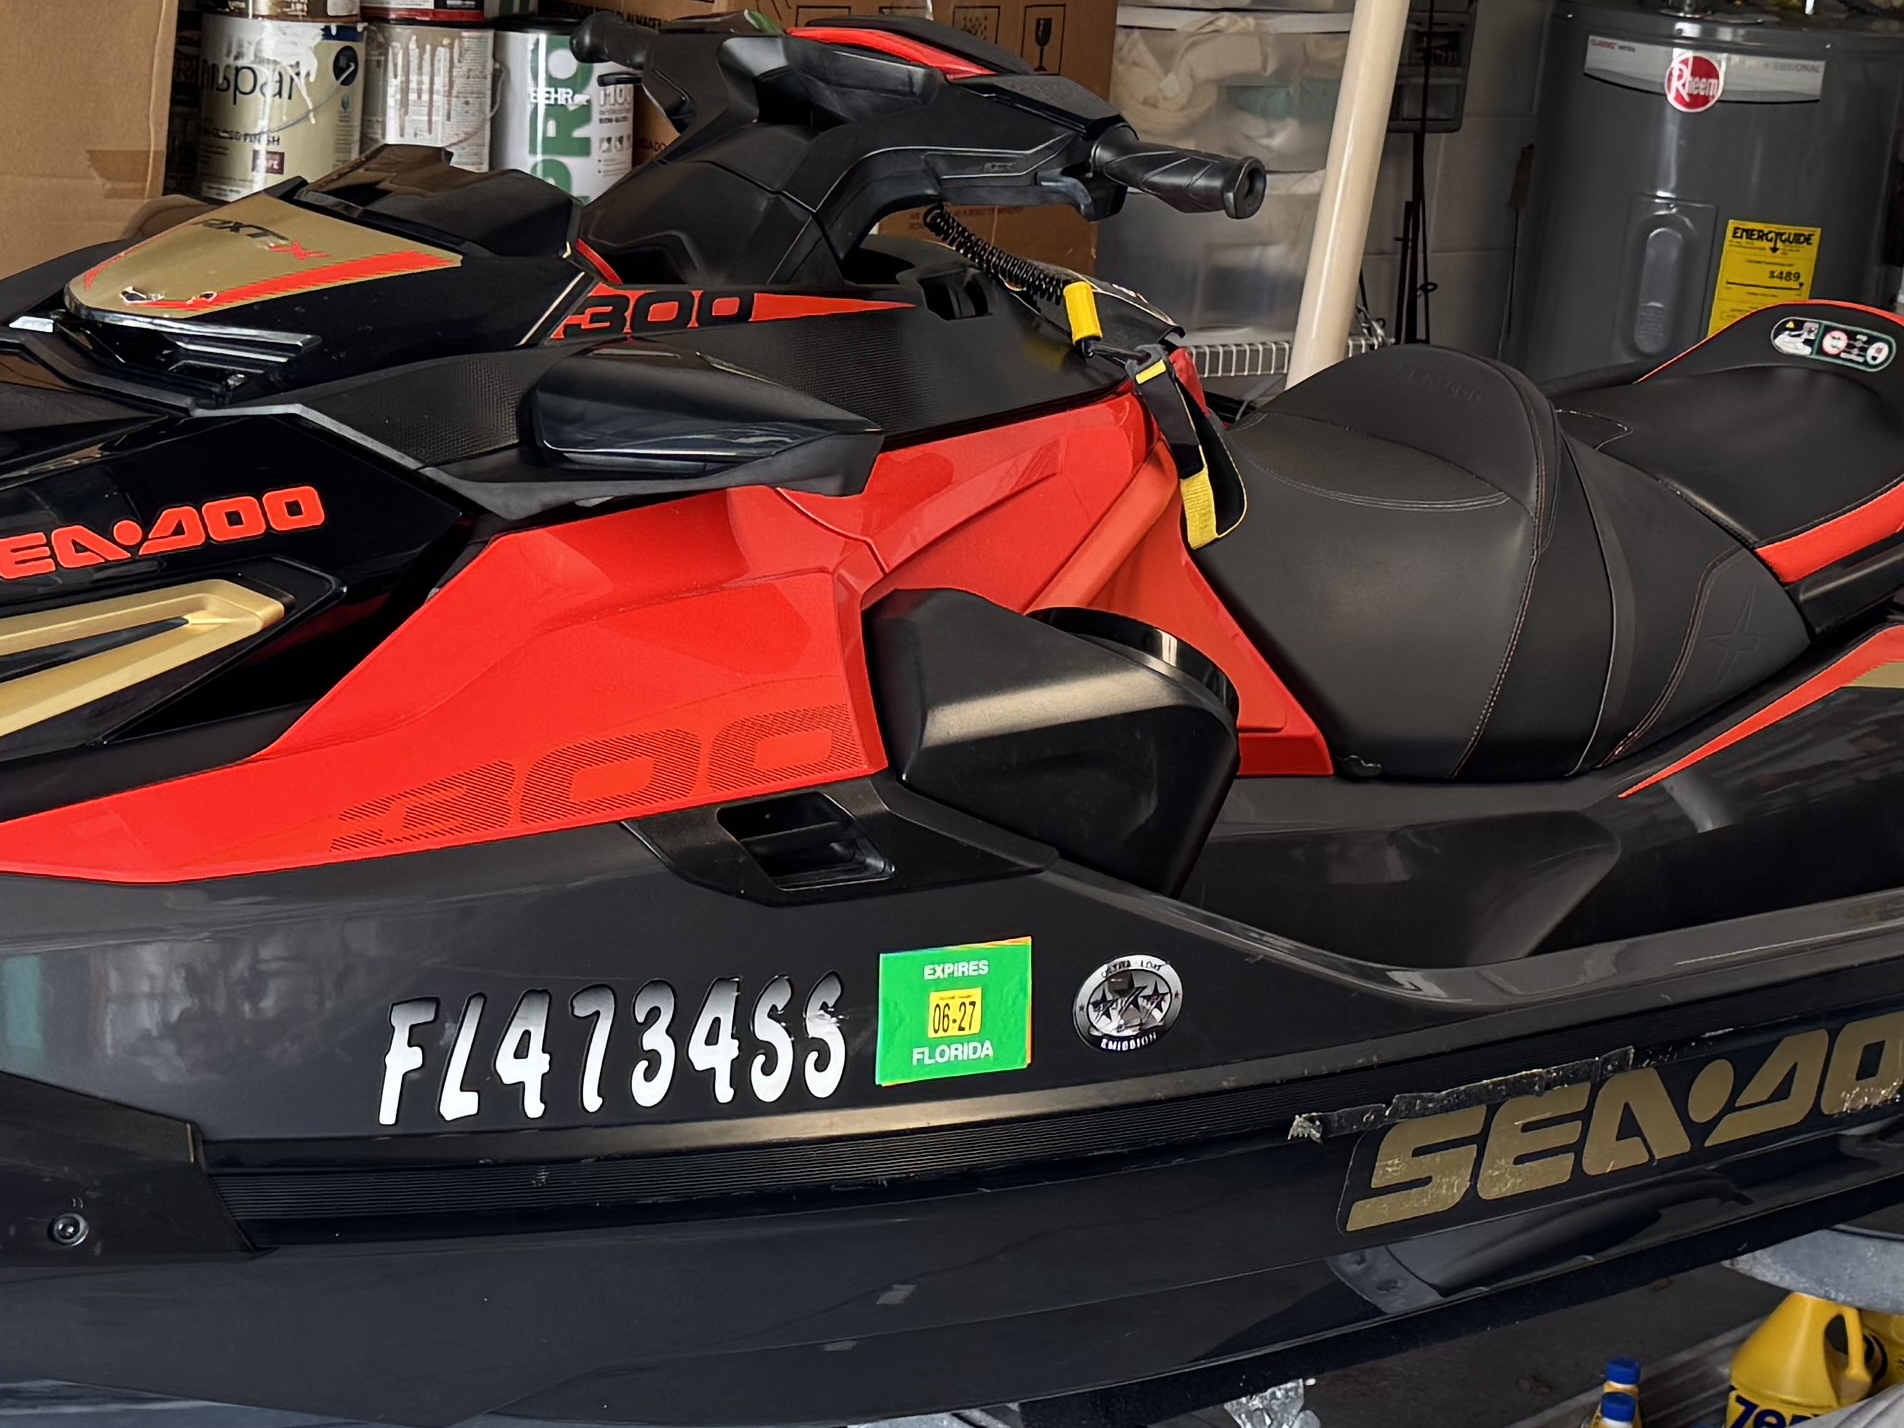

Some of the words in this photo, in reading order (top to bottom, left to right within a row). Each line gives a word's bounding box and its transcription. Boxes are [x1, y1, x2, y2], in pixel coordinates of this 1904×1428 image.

[530, 86, 574, 105] BEHR
[1669, 61, 1718, 102] Rheem
[196, 215, 291, 246] RXT
[565, 290, 754, 337] 300
[922, 959, 989, 981] EXPIRES
[932, 999, 978, 1038] 06-27
[911, 1041, 994, 1067] FLORIDA
